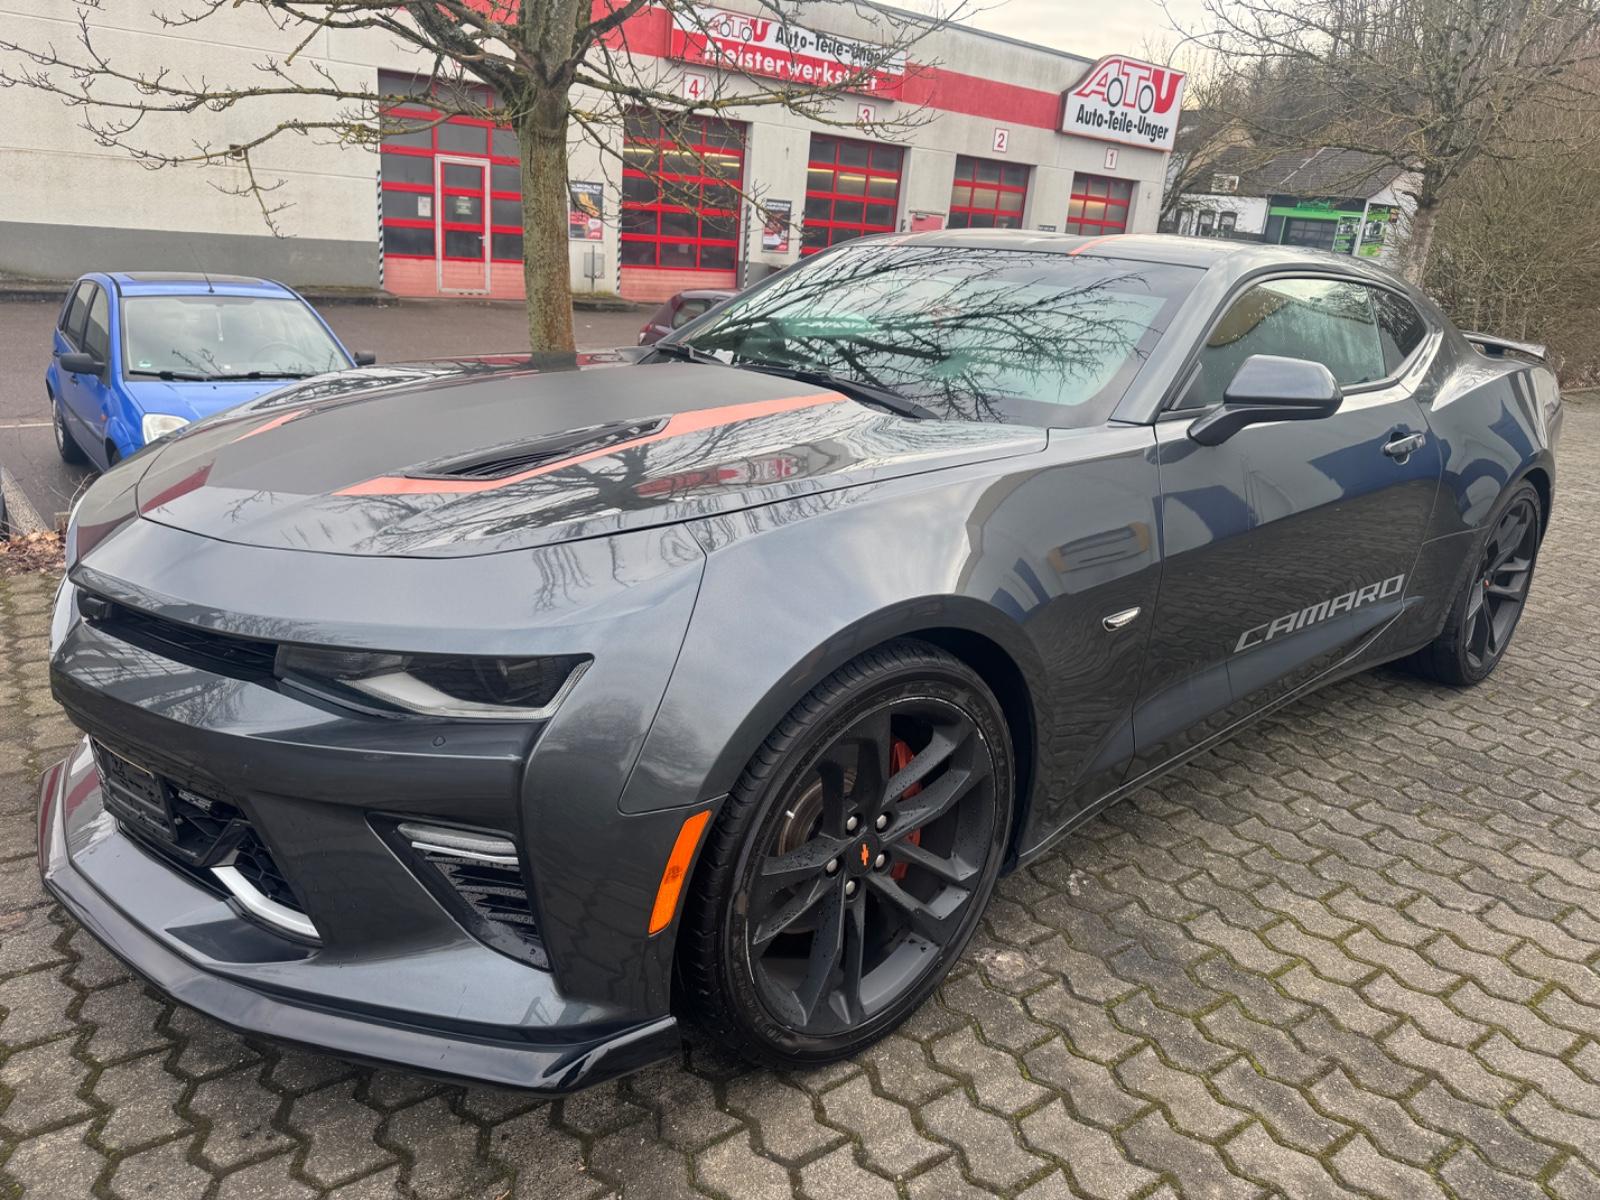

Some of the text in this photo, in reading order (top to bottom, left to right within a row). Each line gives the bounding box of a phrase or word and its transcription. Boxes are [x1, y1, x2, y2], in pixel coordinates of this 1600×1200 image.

[688, 79, 699, 98] 4
[862, 108, 871, 127] 3
[1075, 104, 1169, 142] Auto-Teile-Unger
[997, 132, 1005, 149] 2
[1109, 152, 1115, 167] 1
[1233, 573, 1405, 653] CAMARO
